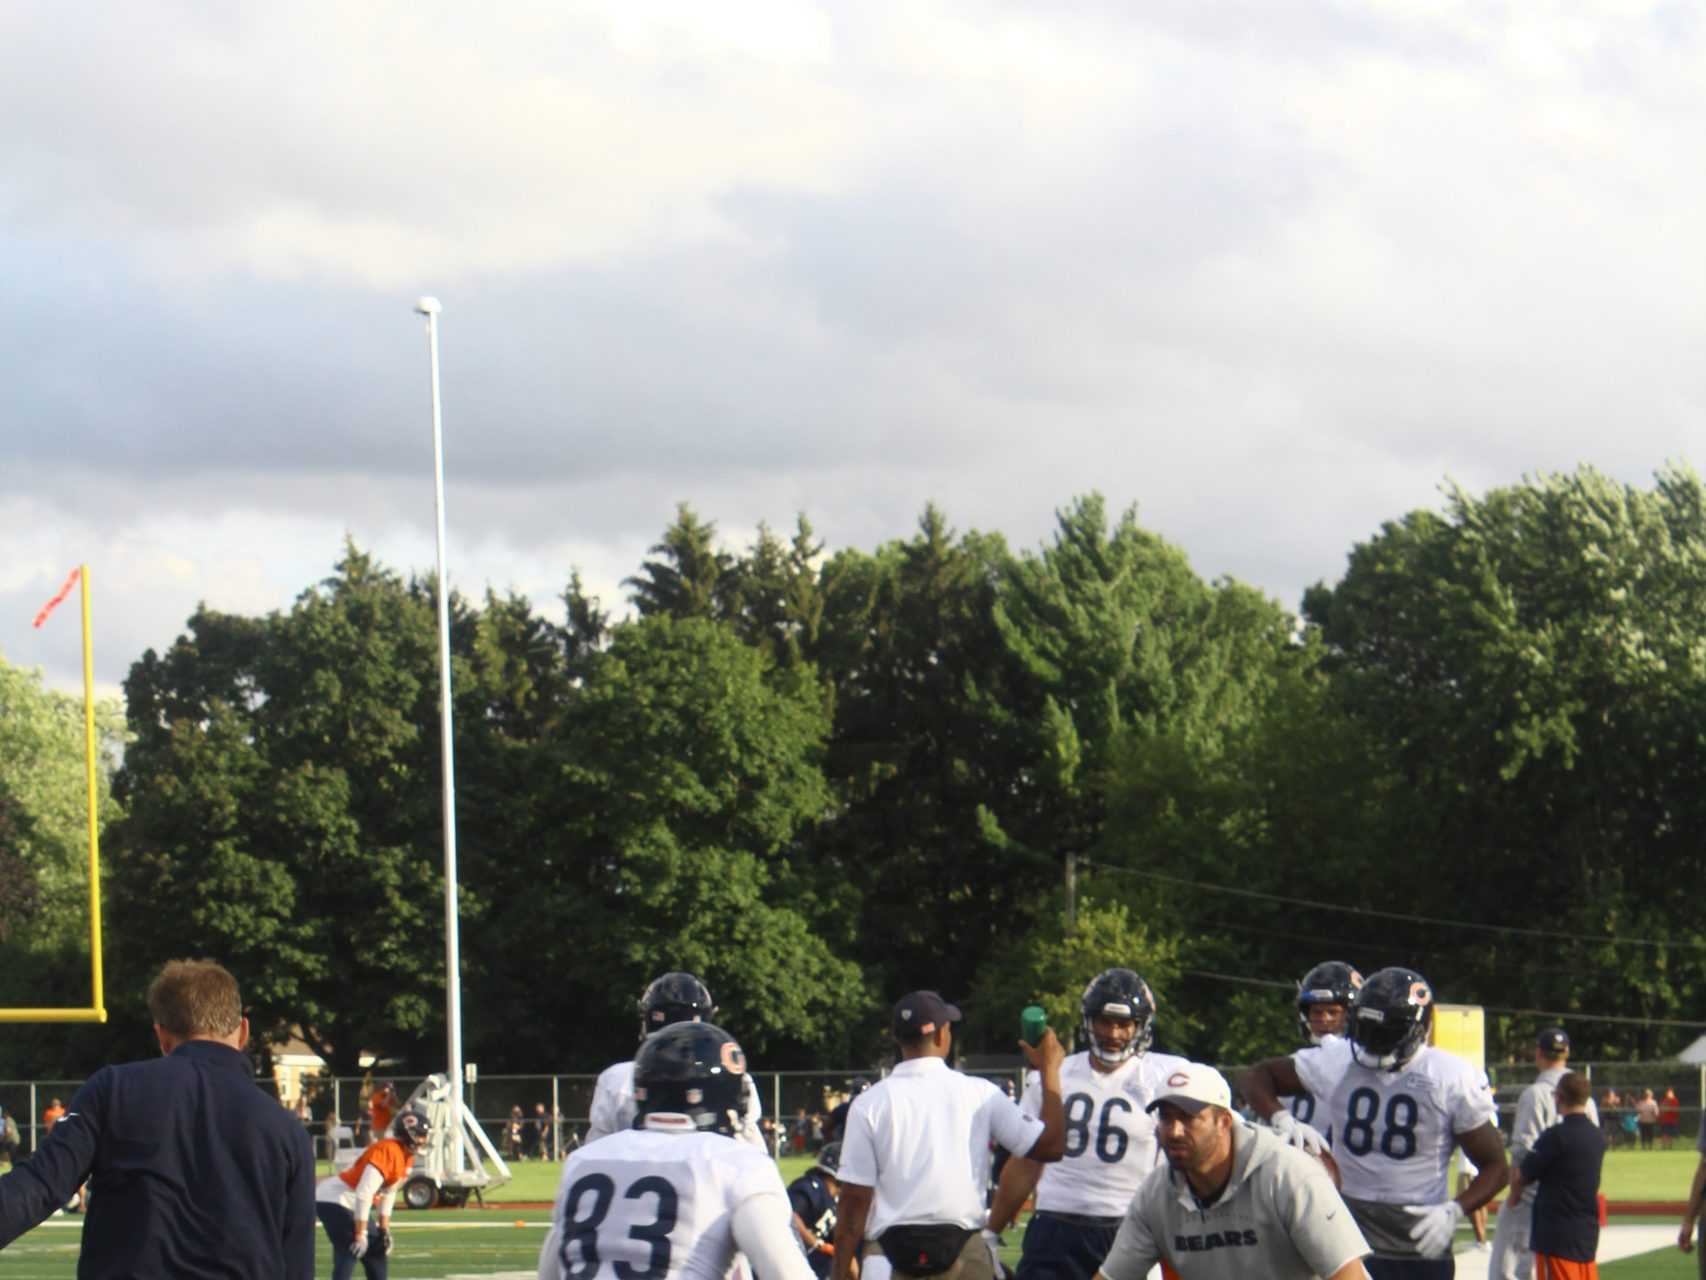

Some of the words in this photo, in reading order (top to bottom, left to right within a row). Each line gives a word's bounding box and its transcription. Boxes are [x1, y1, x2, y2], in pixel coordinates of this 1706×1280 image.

[1167, 1073, 1190, 1088] C
[1065, 1092, 1132, 1163] 86
[1344, 1087, 1418, 1160] 88
[1174, 1229, 1258, 1252] BEARS
